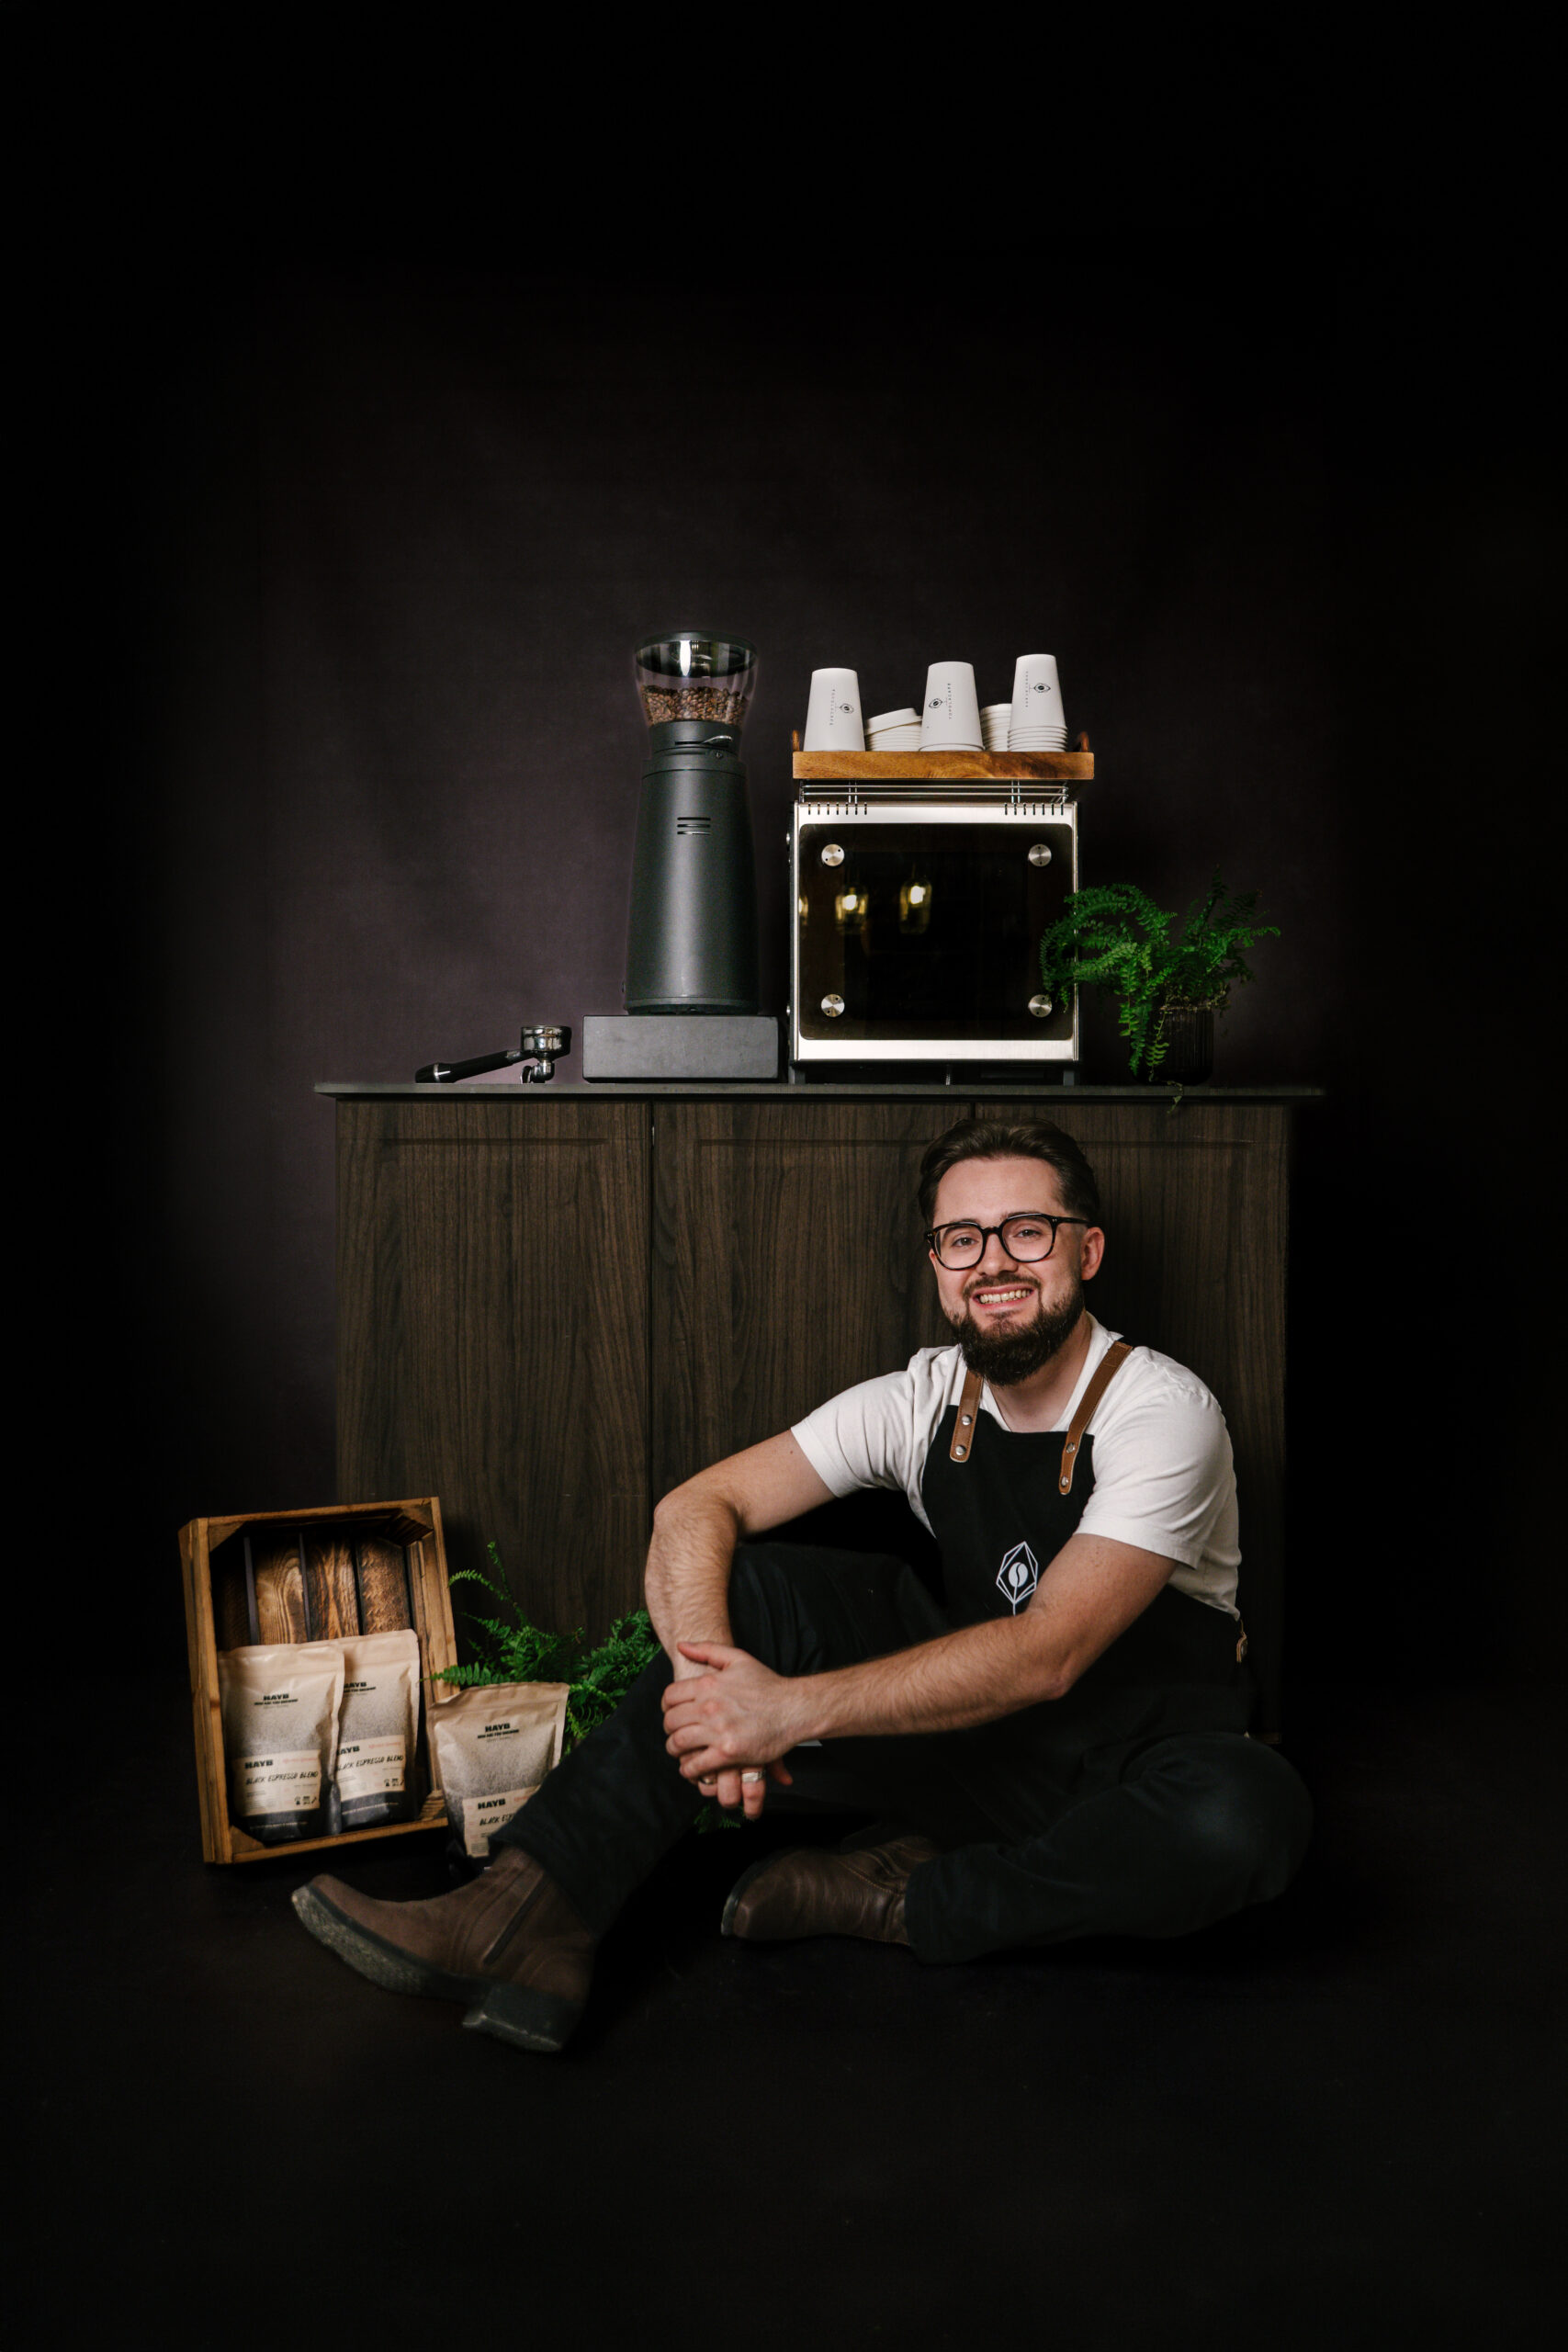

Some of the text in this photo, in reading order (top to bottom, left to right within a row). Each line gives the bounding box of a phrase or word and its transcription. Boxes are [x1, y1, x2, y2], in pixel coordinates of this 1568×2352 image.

[485, 1723, 511, 1733] HAYB
[244, 1758, 274, 1769] HAYB
[356, 1756, 385, 1768] ESPRESSO
[386, 1754, 404, 1763] BLEND
[267, 1771, 299, 1782] ESPRESSO
[299, 1770, 319, 1779] BLEND
[478, 1798, 506, 1809] HAYB
